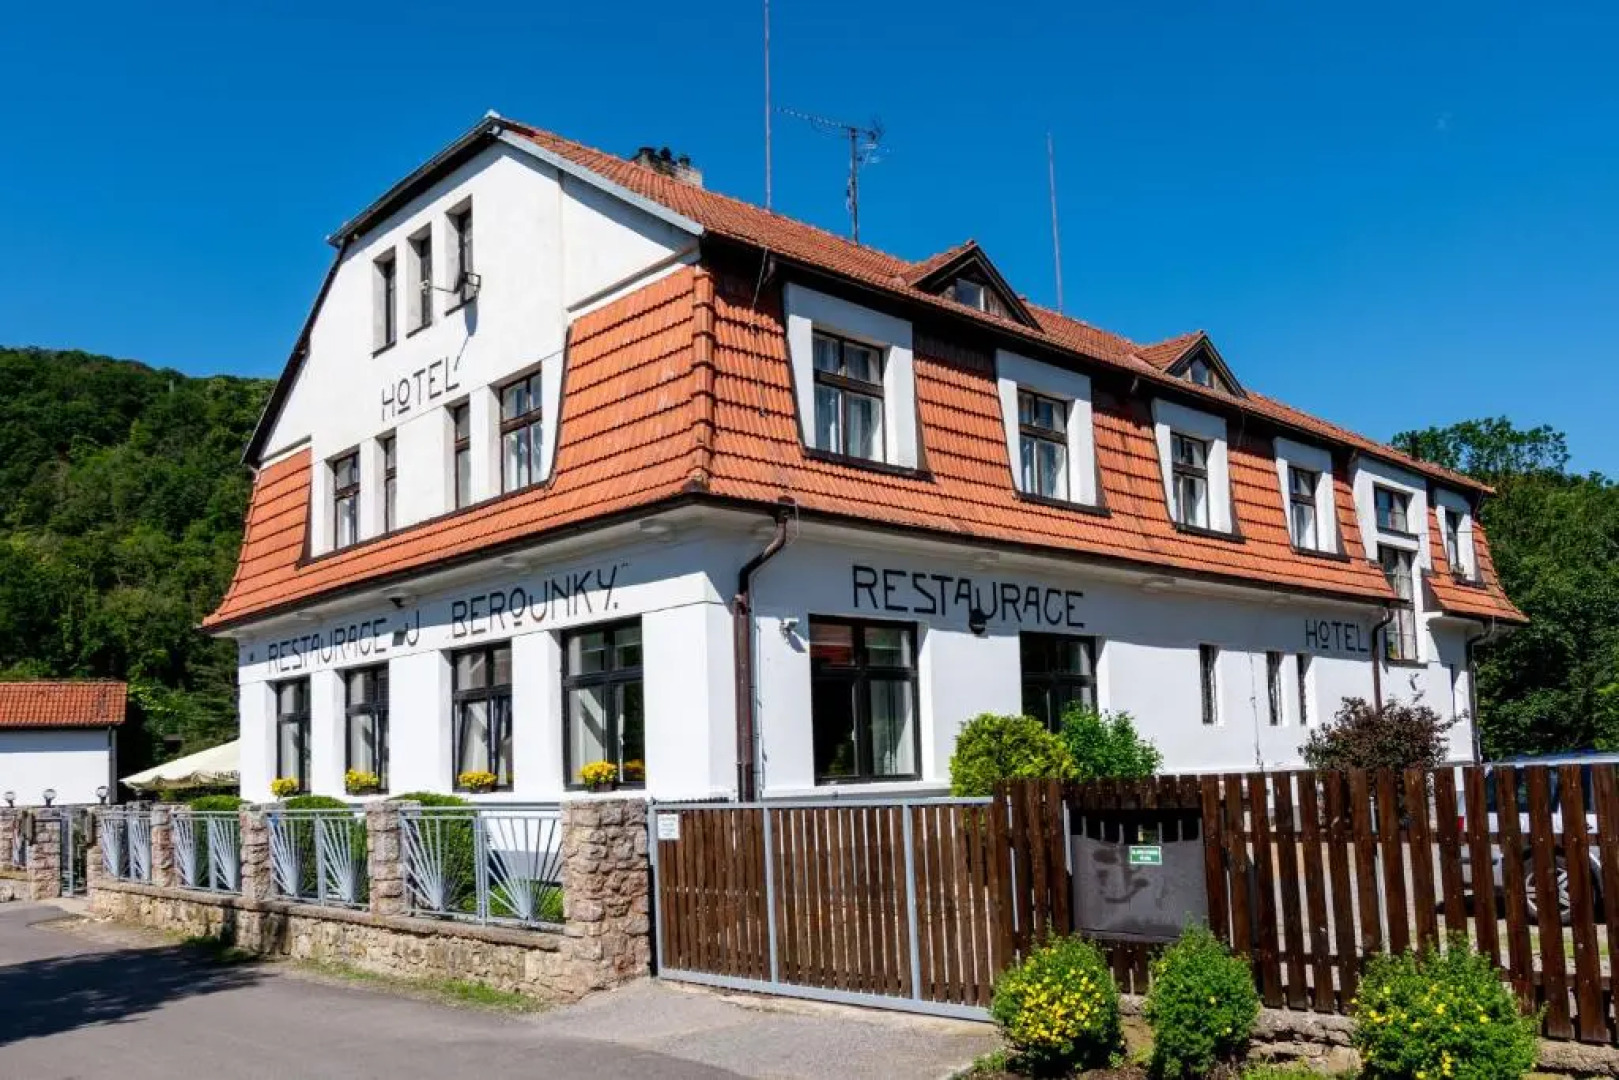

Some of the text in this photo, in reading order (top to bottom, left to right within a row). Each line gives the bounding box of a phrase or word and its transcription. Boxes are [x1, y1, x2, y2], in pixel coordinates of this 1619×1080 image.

[381, 356, 460, 422] HOTEL
[852, 565, 1085, 629] RESTAURACE
[268, 617, 387, 674] RESTAURACE
[404, 609, 420, 647] U
[1304, 618, 1369, 653] HOTEL
